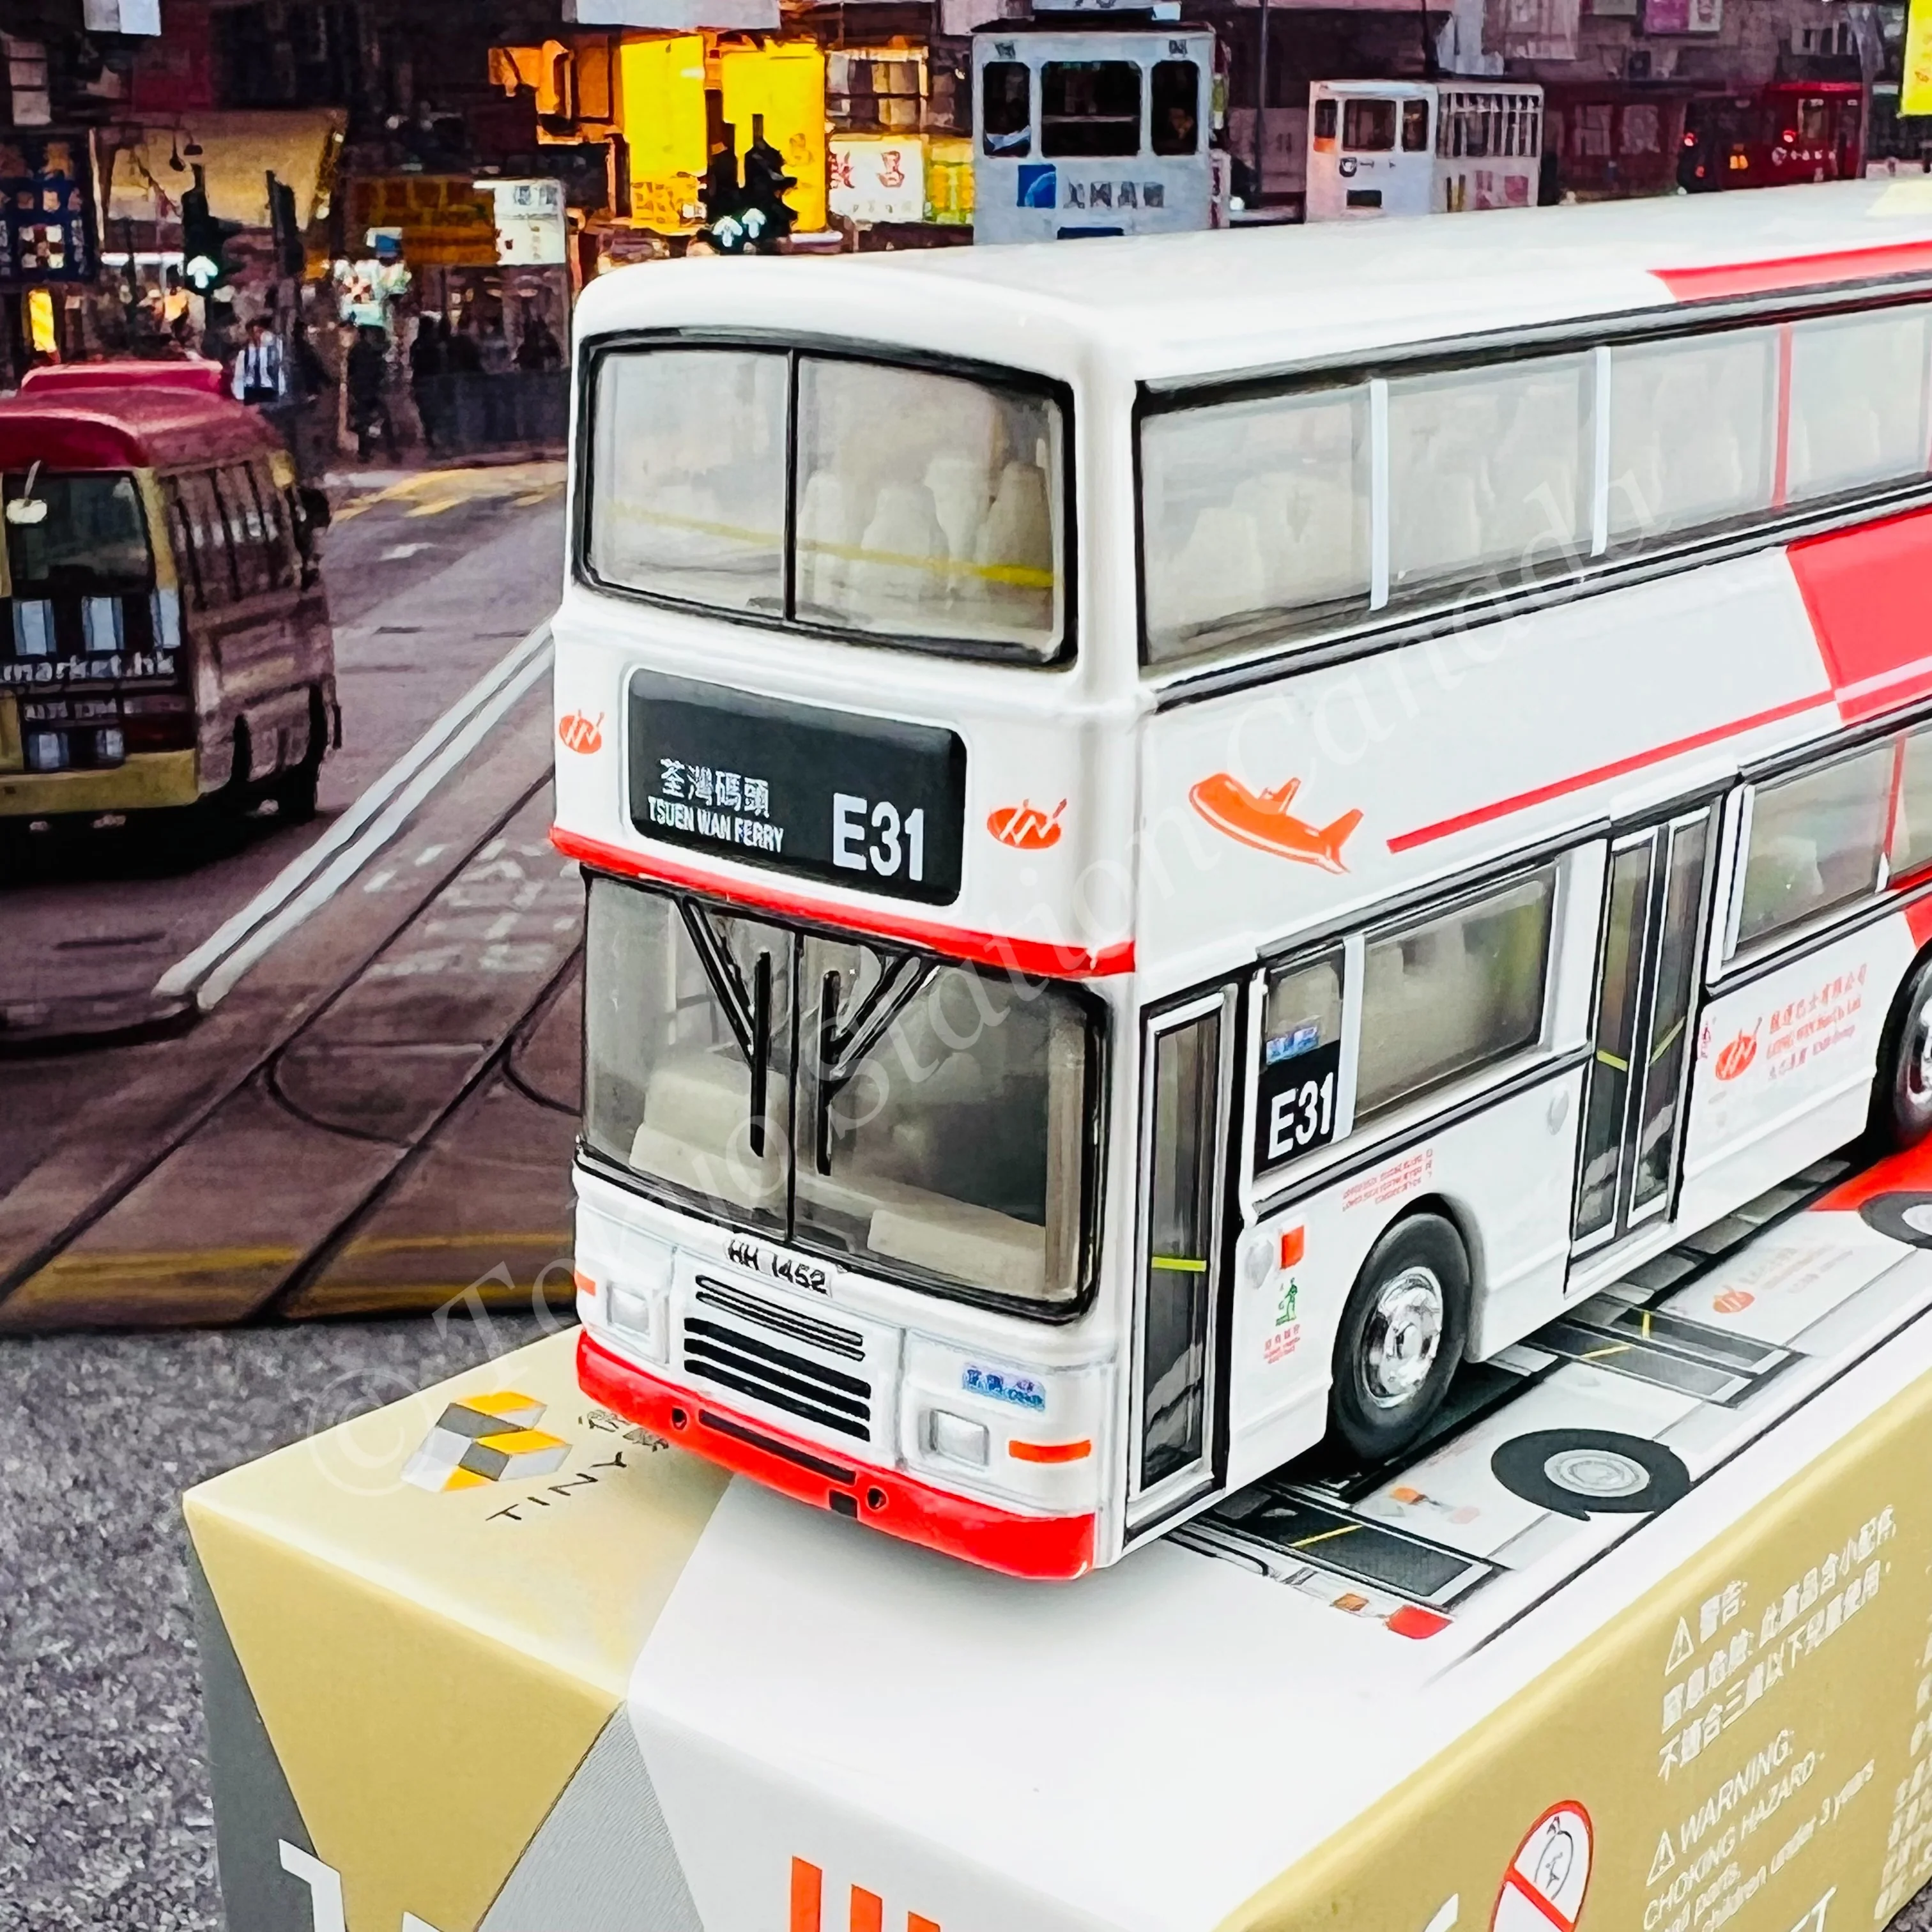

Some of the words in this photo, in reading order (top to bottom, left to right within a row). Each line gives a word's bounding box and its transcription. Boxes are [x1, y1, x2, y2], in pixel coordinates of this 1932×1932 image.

[647, 795, 694, 832] TSUEN
[697, 808, 731, 841] WAN
[735, 818, 784, 853] FERRY
[833, 792, 924, 881] E31
[1268, 1072, 1333, 1160] E31
[772, 1254, 828, 1295] 1452
[486, 1451, 627, 1521] TINY
[1644, 1825, 1736, 1931] CHOKING
[1740, 1751, 1816, 1841] HAZARD
